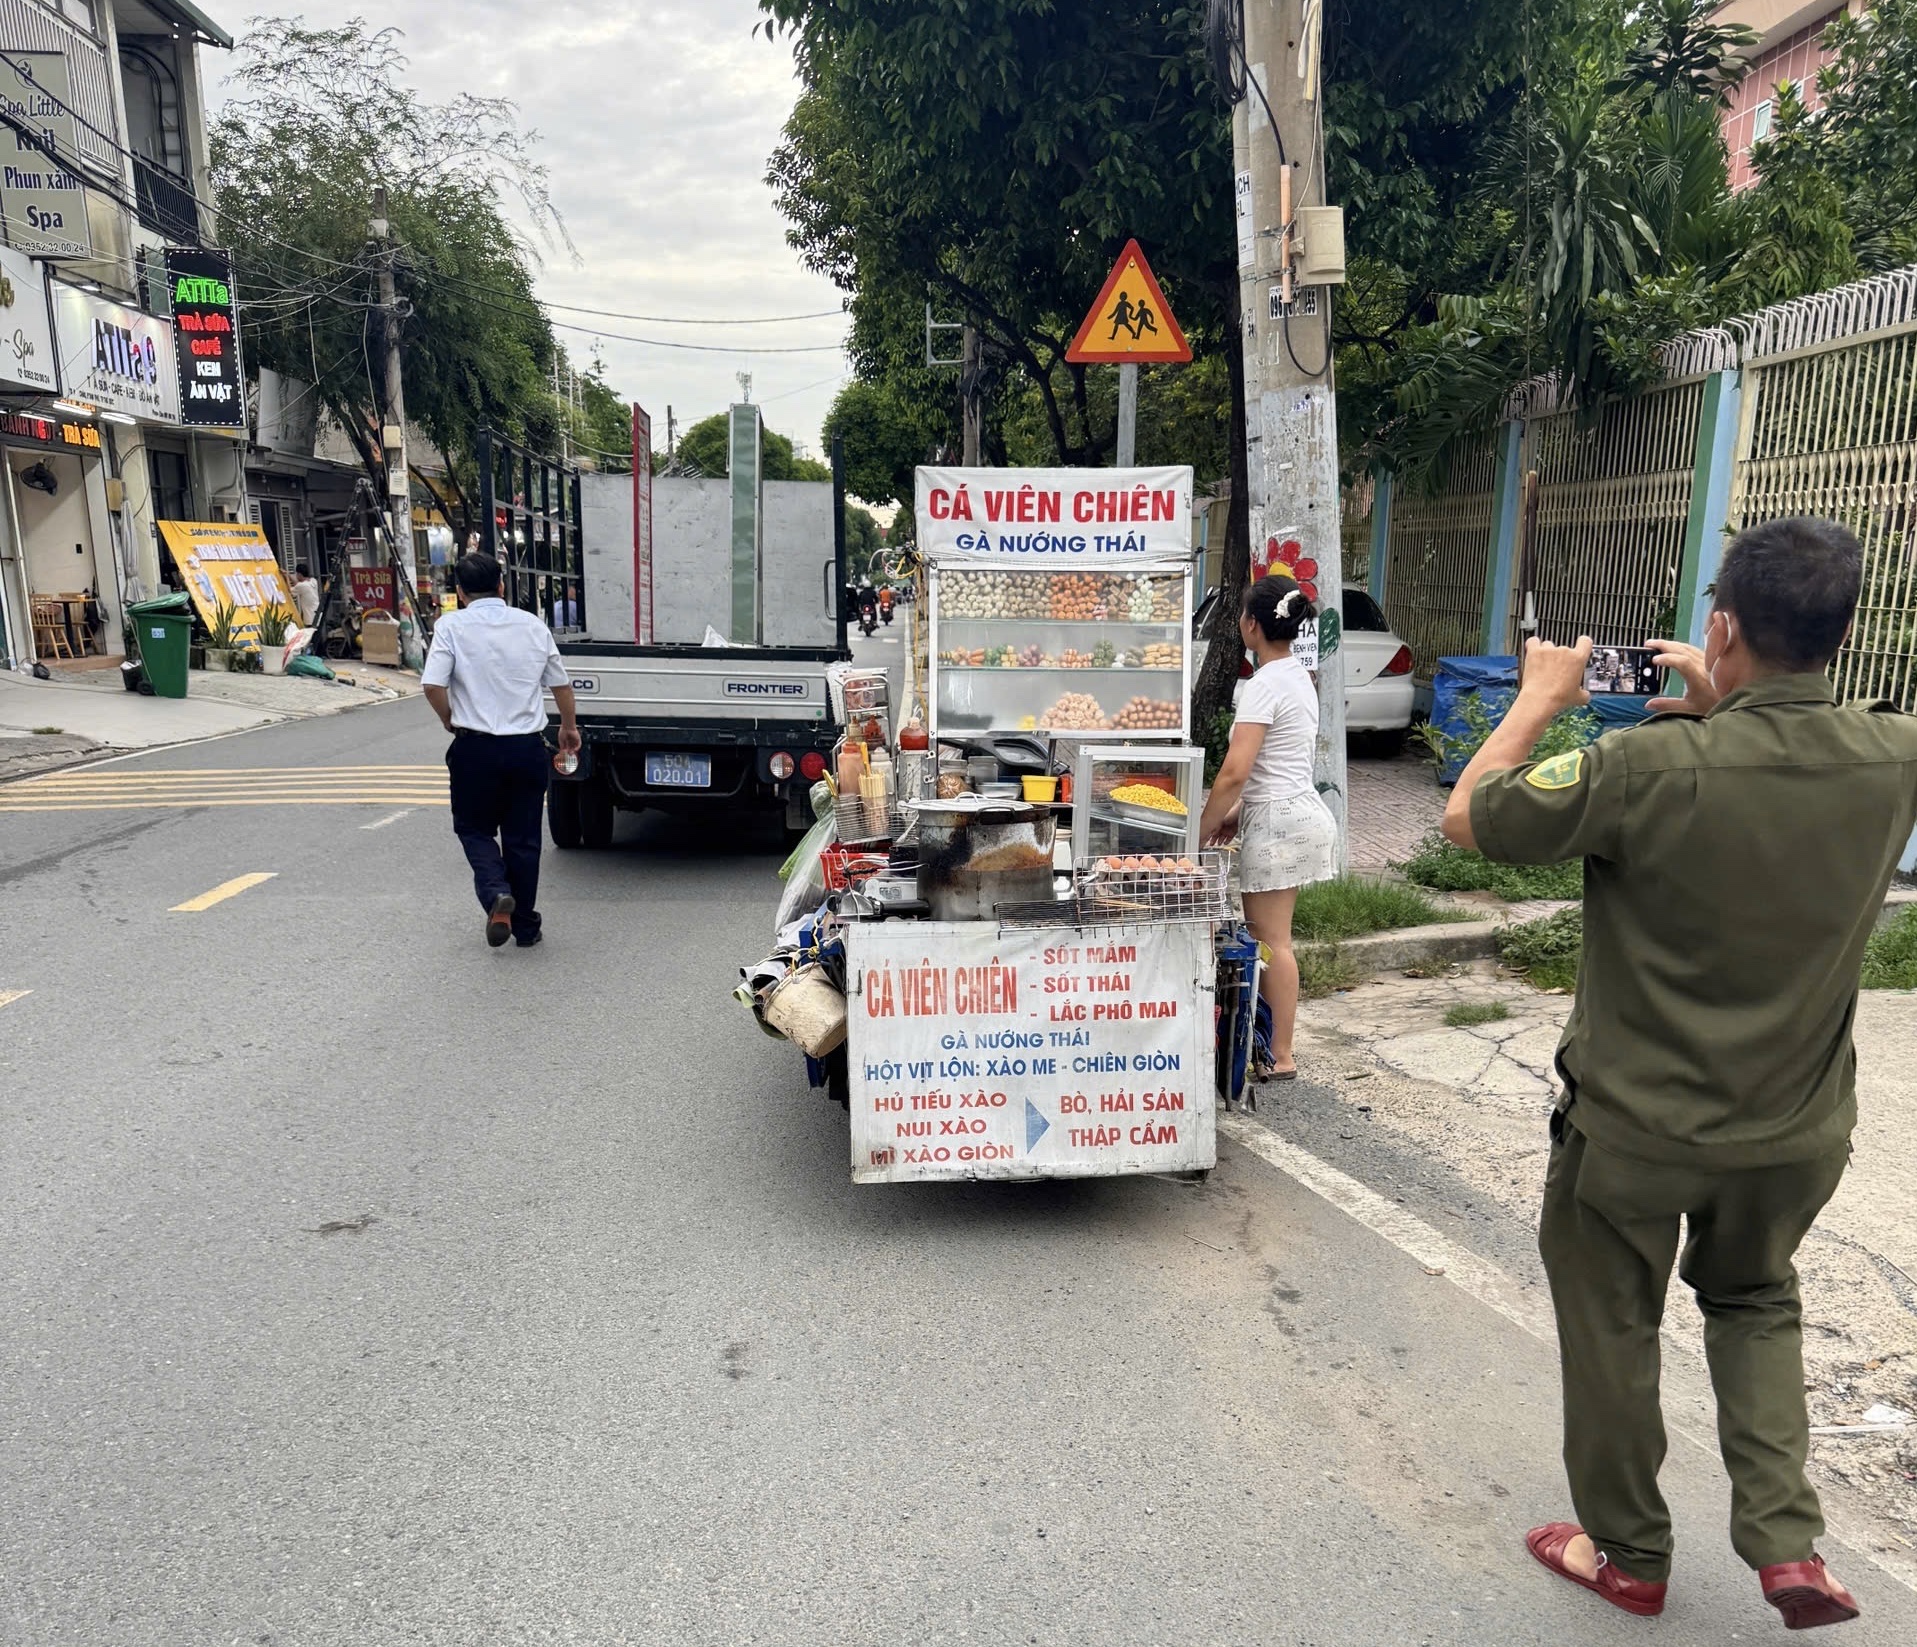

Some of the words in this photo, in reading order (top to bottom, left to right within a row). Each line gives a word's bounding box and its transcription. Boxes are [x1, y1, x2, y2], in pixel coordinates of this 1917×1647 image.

[29, 95, 65, 117] Little
[4, 166, 42, 189] Phun
[46, 168, 77, 190] xăm
[26, 205, 64, 231] Spa
[178, 312, 204, 331] TRÀ
[204, 312, 230, 331] SỮA
[13, 328, 34, 368] Spa
[190, 337, 222, 356] CAFÉ
[196, 361, 221, 377] KEM
[190, 380, 207, 400] ĂN
[208, 382, 232, 403] VẶT
[62, 421, 82, 445] TRÀ
[82, 423, 101, 448] SỮA
[929, 483, 973, 521] CÁ
[984, 484, 1061, 522] VIÊN
[1072, 484, 1175, 522] CHIÊN
[956, 530, 991, 552] GÀ
[999, 530, 1086, 553] NƯỚNG
[1093, 530, 1146, 552] THÁI
[354, 571, 371, 585] Trà
[728, 683, 804, 695] FRONTIER
[653, 768, 702, 784] 020.01
[1043, 943, 1080, 965] SỐT
[1087, 940, 1136, 964] MẮM
[866, 958, 895, 1018] CÁ
[900, 957, 948, 1016] VIÊN
[954, 955, 1017, 1015] CHIÊN
[1043, 970, 1080, 993] SỐT
[1086, 971, 1130, 992] THÁI
[1050, 999, 1087, 1022] LẮC
[1093, 1000, 1132, 1020] PHÔ
[1139, 1000, 1177, 1018] MAI
[941, 1030, 968, 1049] GÀ
[975, 1029, 1044, 1049] NƯỚNG
[1049, 1027, 1090, 1047] THÁI
[867, 1059, 902, 1085] HỘT
[908, 1061, 934, 1083] VỊT
[940, 1056, 980, 1082] LỘN:
[986, 1055, 1027, 1077] XÀO
[1032, 1058, 1057, 1075] ME
[1072, 1051, 1126, 1073] CHIÊN
[1132, 1050, 1180, 1071] GIÒN
[874, 1091, 904, 1112] HỦ
[910, 1088, 952, 1110] TIẾU
[959, 1089, 1007, 1108] XÀO
[1060, 1090, 1092, 1115] BÒ,
[1100, 1087, 1134, 1113] HẢI
[1142, 1086, 1184, 1112] SẢN
[896, 1121, 932, 1138] NUI
[939, 1115, 987, 1135] XÀO
[1067, 1123, 1121, 1150] THẬP
[1129, 1118, 1178, 1146] CẨM
[903, 1144, 951, 1163] XÀO
[957, 1141, 1014, 1161] GIÒN
